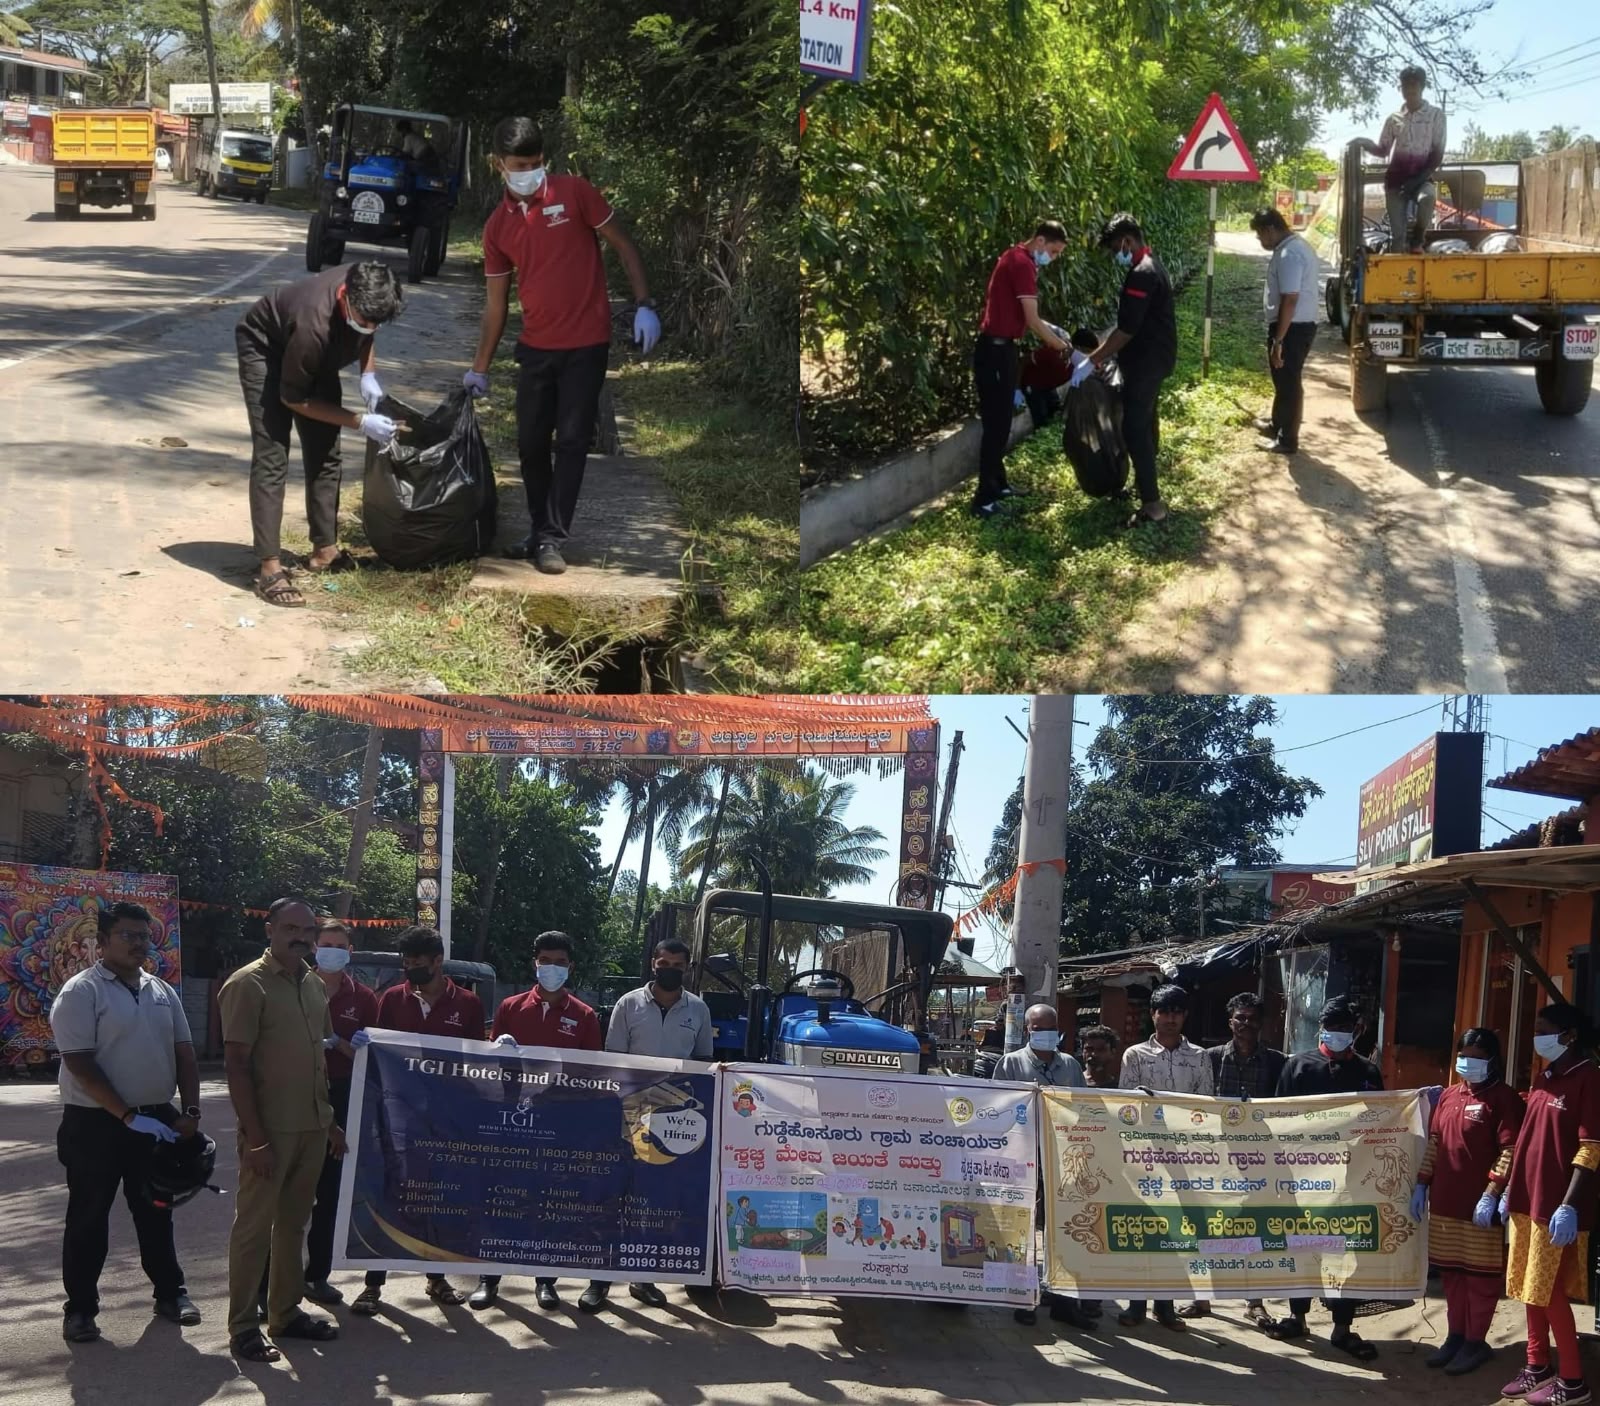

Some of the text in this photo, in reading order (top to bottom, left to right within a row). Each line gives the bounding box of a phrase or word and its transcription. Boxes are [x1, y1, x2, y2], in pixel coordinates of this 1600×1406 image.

[829, 2, 855, 21] Km
[1566, 329, 1597, 344] STOP
[1566, 345, 1597, 355] SIGNAL
[487, 740, 519, 750] TEAM
[582, 740, 622, 751] SVSSG
[1359, 834, 1374, 863] SLV
[1375, 821, 1400, 856] PORK
[1401, 805, 1432, 842] STALL
[822, 1051, 901, 1068] SONALIKA
[404, 1057, 621, 1092] TGI Hotels and Resorts
[498, 1110, 534, 1128] TGI
[666, 1115, 697, 1127] We're
[663, 1129, 697, 1142] Hiring
[754, 1120, 1009, 1150] ಗುಡ್ಡೆಹೊಸೂರು ಗ್ರಾಮ ಪಂಚಾಯತ್
[414, 1139, 530, 1156] www.tgihotels.com
[543, 1147, 568, 1158] 1800
[595, 1152, 620, 1162] 3100
[427, 1152, 434, 1161] 7
[490, 1158, 501, 1168] 17
[503, 1159, 538, 1169] CITIES
[552, 1163, 565, 1172] 25
[568, 1164, 611, 1174] HOTELS
[899, 1154, 942, 1178] ಮತ್ತು
[1122, 1147, 1220, 1172] ಗುಡ್ಡೆಹೊಸೂರು
[1228, 1149, 1266, 1170] ಗ್ರಾಮ
[407, 1179, 461, 1192] Bangalore
[494, 1185, 528, 1198] Coorg
[406, 1191, 444, 1202] Bhopal
[546, 1187, 580, 1198] Jaipur
[492, 1197, 516, 1207] Goa
[625, 1194, 649, 1206] Ooty
[404, 1204, 469, 1216] Coimbatore
[491, 1208, 525, 1219] Hosur
[545, 1201, 603, 1213] Krishnagiri
[624, 1206, 683, 1218] Pondicherry
[544, 1213, 583, 1223] Mysore
[623, 1218, 664, 1229] Yercaud
[1207, 1209, 1257, 1236] ಸೇವಾ
[1266, 1209, 1373, 1236] ಆಂದೋಲನ
[481, 1238, 701, 1257] careers@tgihotels.com 90872 38989
[478, 1249, 700, 1270] hr.redolent@gmail.com 90190 36643
